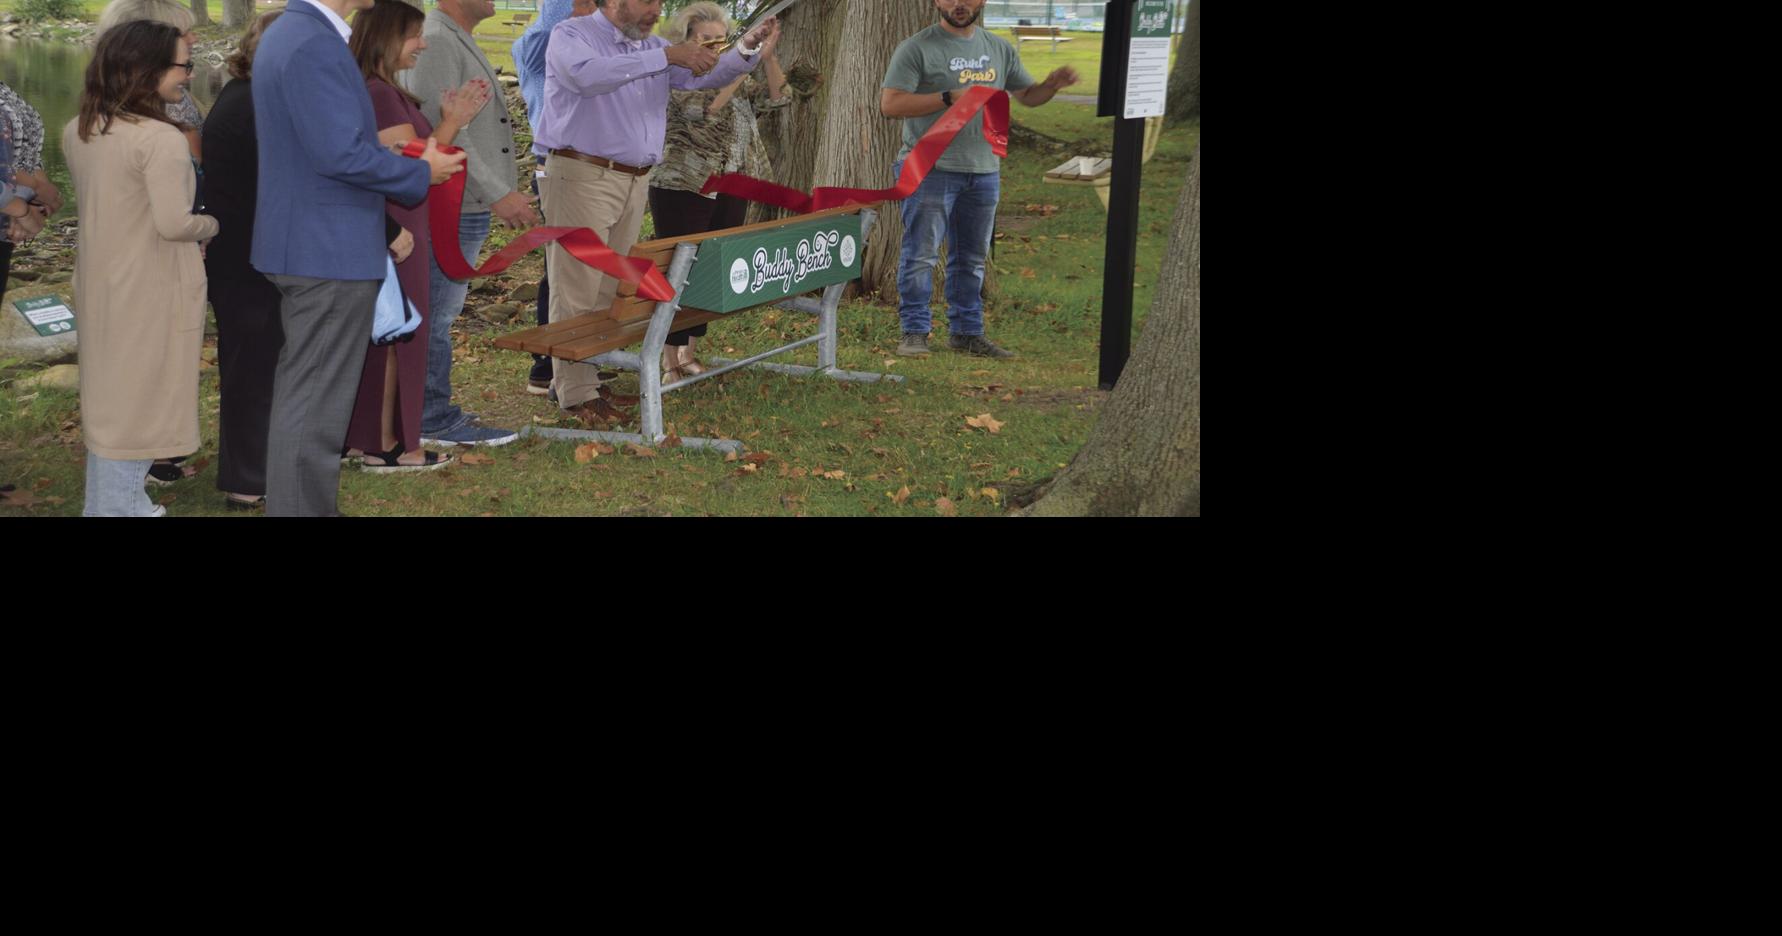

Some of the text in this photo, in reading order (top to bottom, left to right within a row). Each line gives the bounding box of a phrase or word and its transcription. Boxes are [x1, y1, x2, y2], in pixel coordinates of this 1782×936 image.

[959, 67, 996, 84] Park
[751, 230, 839, 293] Buddy Bench
